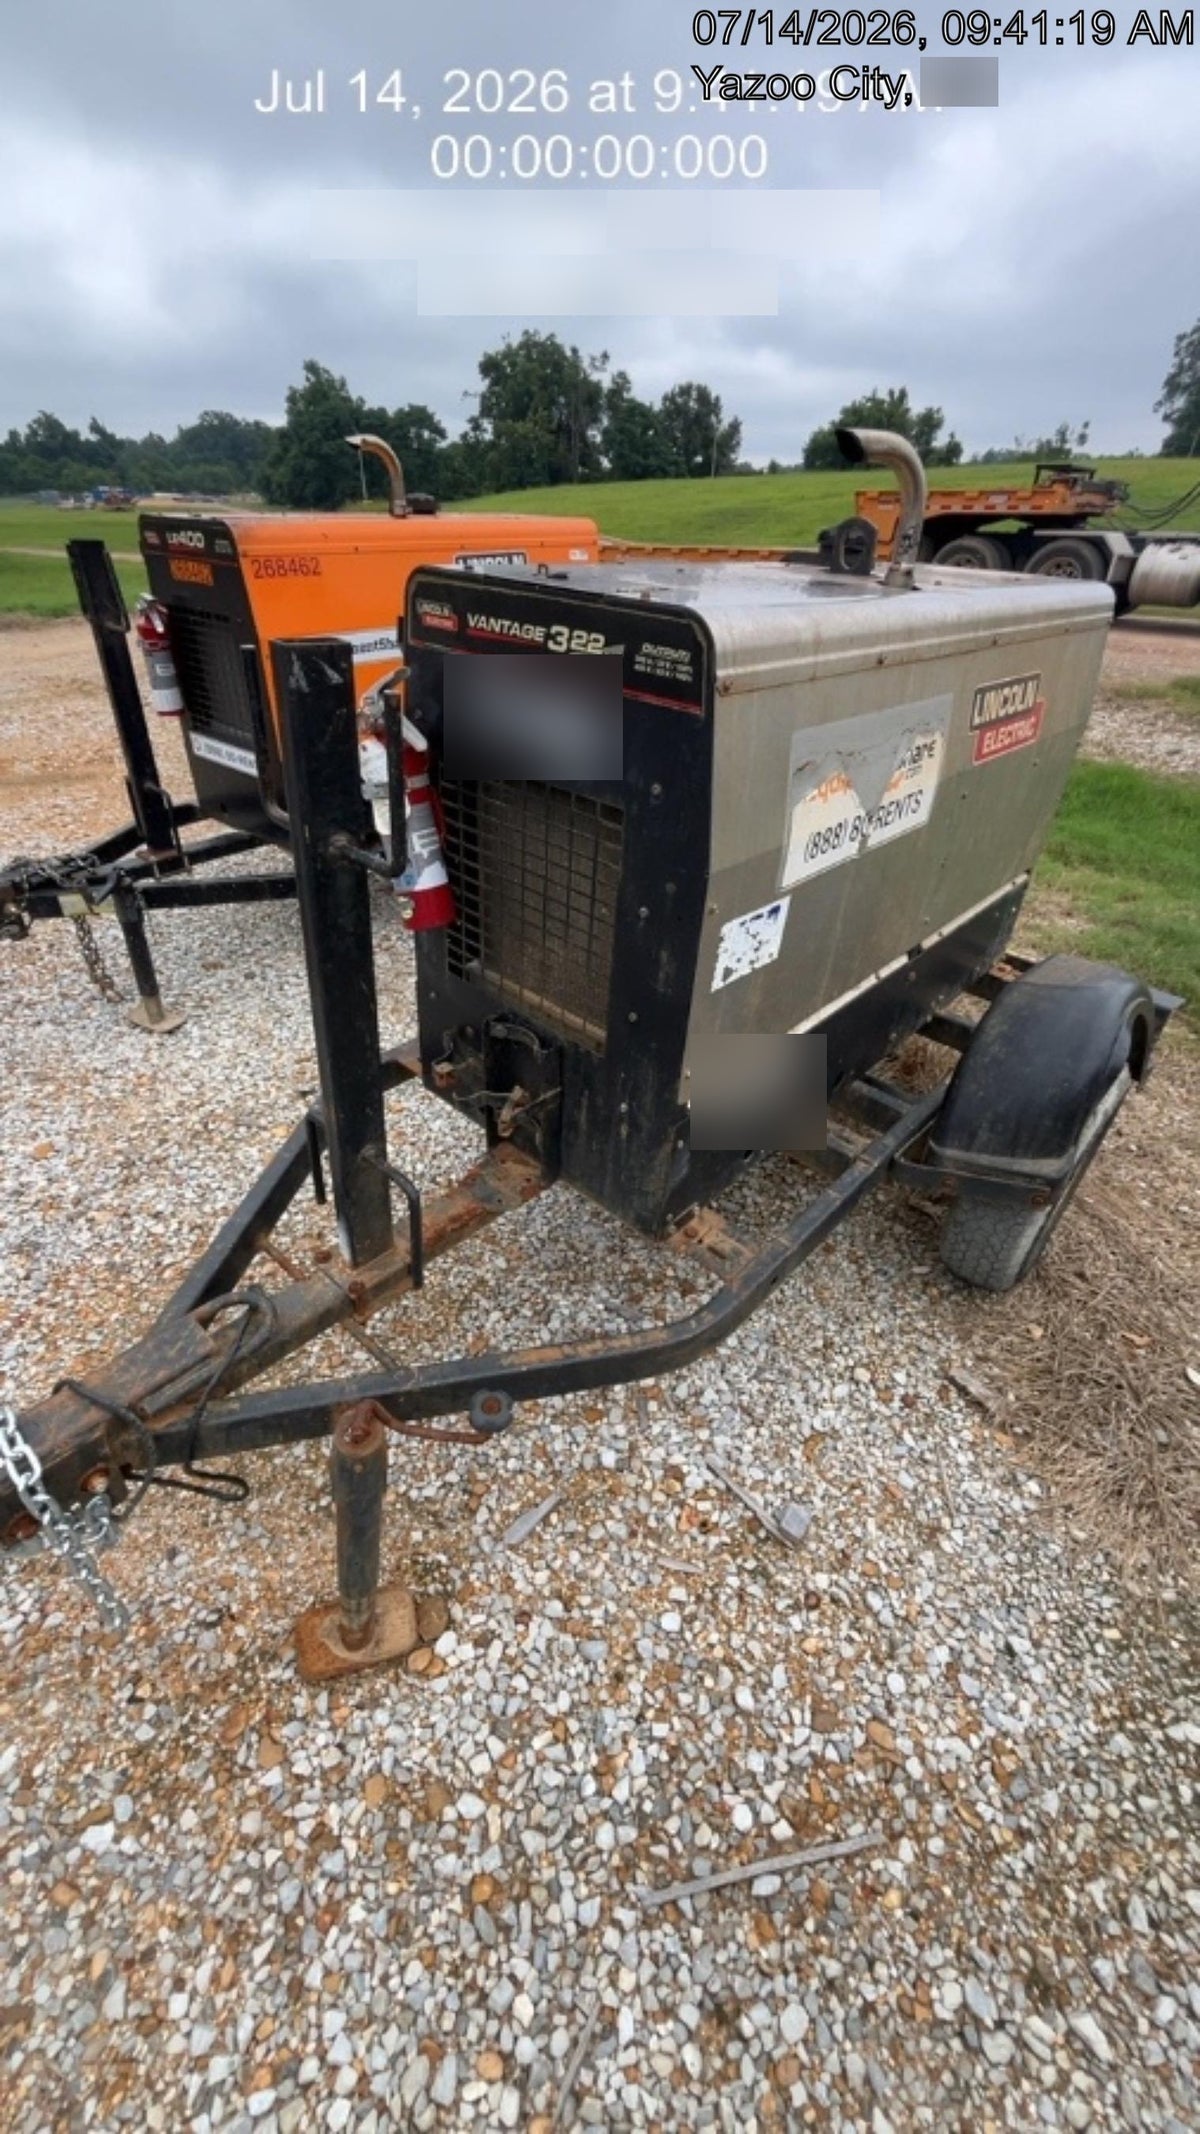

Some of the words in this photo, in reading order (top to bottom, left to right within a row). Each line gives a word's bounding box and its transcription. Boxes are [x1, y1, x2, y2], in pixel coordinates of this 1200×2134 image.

[467, 612, 547, 642] VANTAGE
[547, 625, 607, 655] 322
[972, 680, 1039, 727] LINCOLN
[981, 715, 1037, 755] ELECTRIC
[803, 818, 849, 863] (888)
